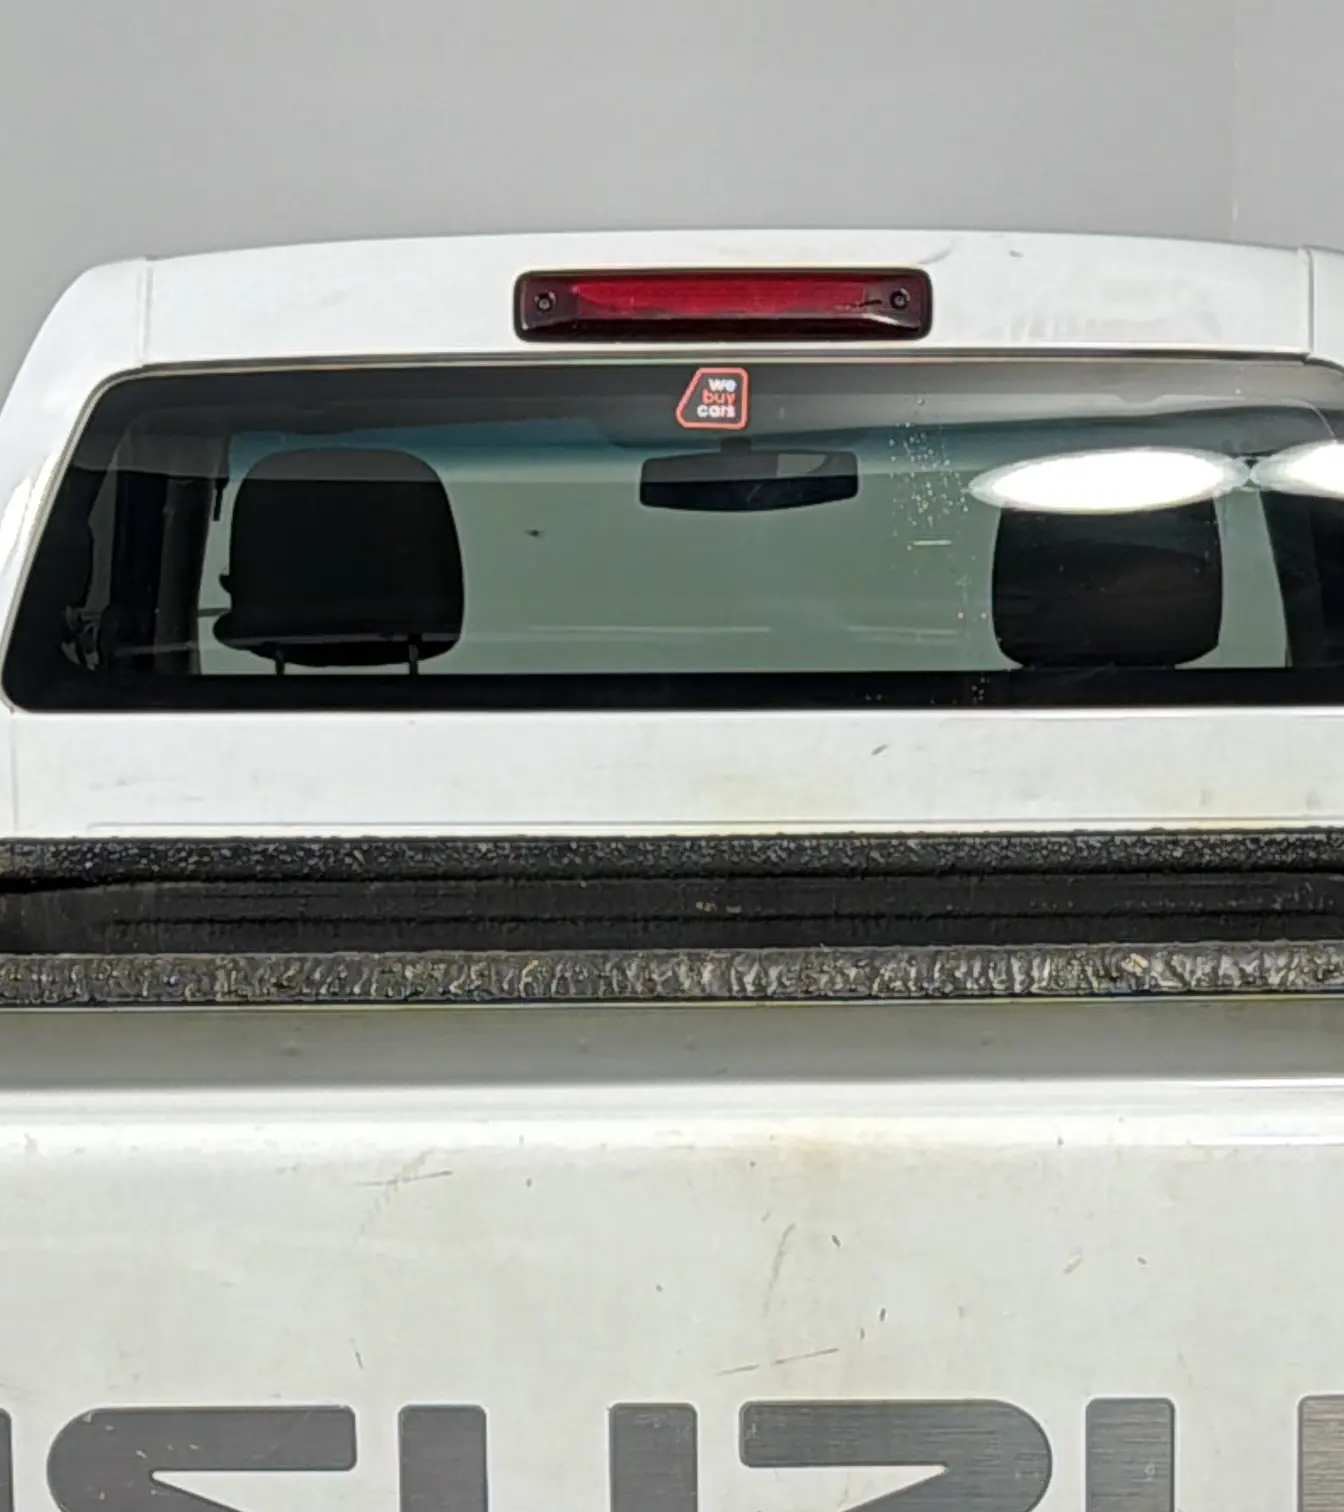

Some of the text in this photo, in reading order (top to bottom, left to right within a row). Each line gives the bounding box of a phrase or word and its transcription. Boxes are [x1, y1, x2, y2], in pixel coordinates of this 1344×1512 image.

[709, 379, 737, 392] we
[702, 389, 736, 407] buy
[697, 404, 736, 418] cars
